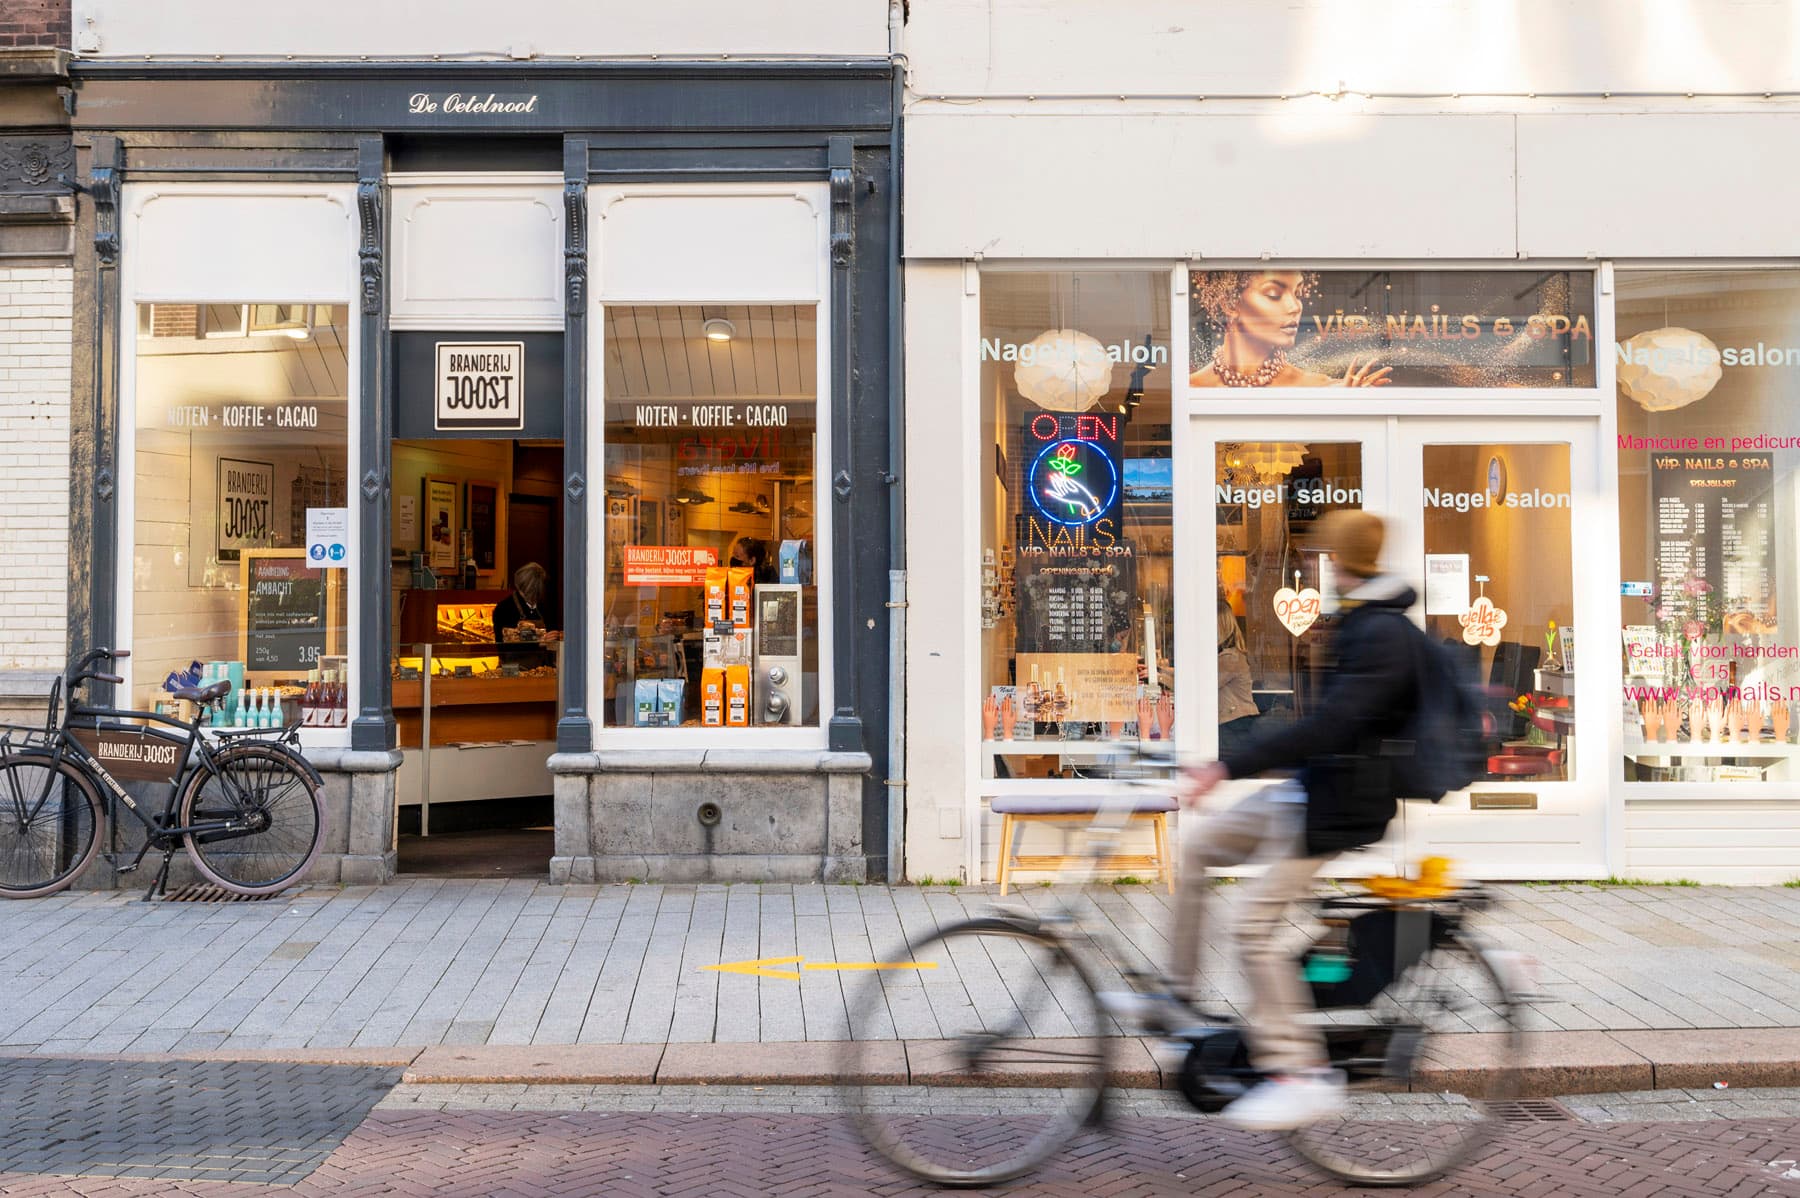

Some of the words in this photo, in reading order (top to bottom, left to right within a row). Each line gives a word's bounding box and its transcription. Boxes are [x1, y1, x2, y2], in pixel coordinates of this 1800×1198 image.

[409, 93, 438, 113] De
[443, 93, 538, 113] Oetelnoot
[1527, 314, 1593, 340] SPA
[1089, 340, 1167, 363] salon
[1722, 342, 1800, 366] salon
[450, 354, 511, 372] BRANDERIJ
[447, 376, 514, 409] JOOST
[167, 406, 208, 426] NOTEN
[223, 406, 265, 427] KOFFIE
[276, 406, 318, 427] CACAO
[636, 405, 678, 427] NOTEN
[692, 405, 734, 427] KOFFIE
[746, 405, 788, 427] CACAO
[1031, 414, 1117, 441] OPEN
[1617, 434, 1698, 450] Manicure
[1704, 437, 1725, 449] en
[1685, 458, 1725, 470] NAILS
[1742, 458, 1770, 470] SPA
[227, 470, 268, 495] BRANDERIJ
[1216, 484, 1283, 509] Nagel
[1297, 484, 1363, 504] salon
[1424, 488, 1490, 512] Nagel
[1505, 488, 1570, 508] salon
[225, 497, 268, 540] JOOST
[1030, 516, 1116, 550] NAILS
[628, 549, 665, 562] BRANDERIJ
[665, 550, 692, 565] JOOST
[1049, 546, 1088, 557] NAILS
[1105, 546, 1133, 557] SPA
[256, 582, 293, 596] AMBACHT
[1277, 599, 1319, 624] open
[299, 646, 321, 663] 3.95
[1629, 643, 1684, 658] Gellak
[1688, 646, 1728, 658] voor
[1733, 643, 1798, 658] handen
[1709, 664, 1729, 680] 15
[98, 742, 143, 759] BRANDERIJ
[144, 745, 177, 764] JOOST
